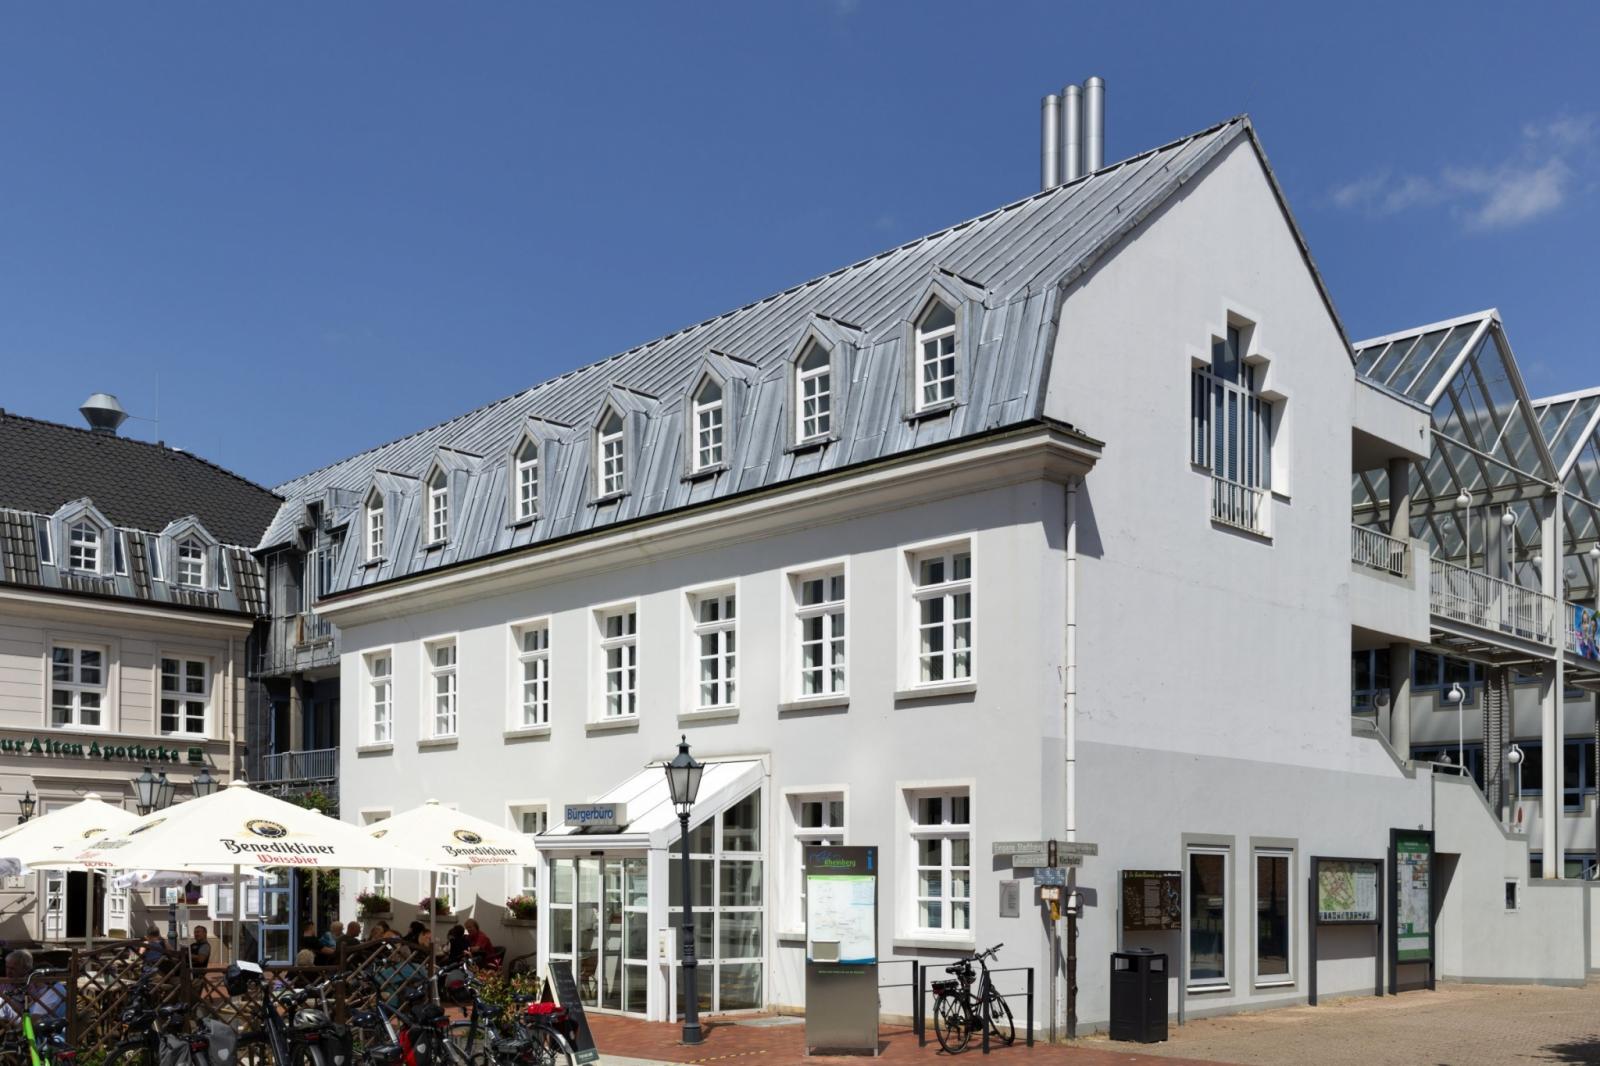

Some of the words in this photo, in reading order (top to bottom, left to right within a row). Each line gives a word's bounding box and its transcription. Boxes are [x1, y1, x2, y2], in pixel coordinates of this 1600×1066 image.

[28, 737, 83, 755] Alten
[88, 741, 179, 760] Apotheke
[567, 807, 614, 822] Bürgerbüro
[219, 839, 335, 855] Benediktiner
[442, 845, 517, 857] Benediktiner
[257, 854, 319, 865] Weissbier
[824, 858, 856, 867] Rheinberg
